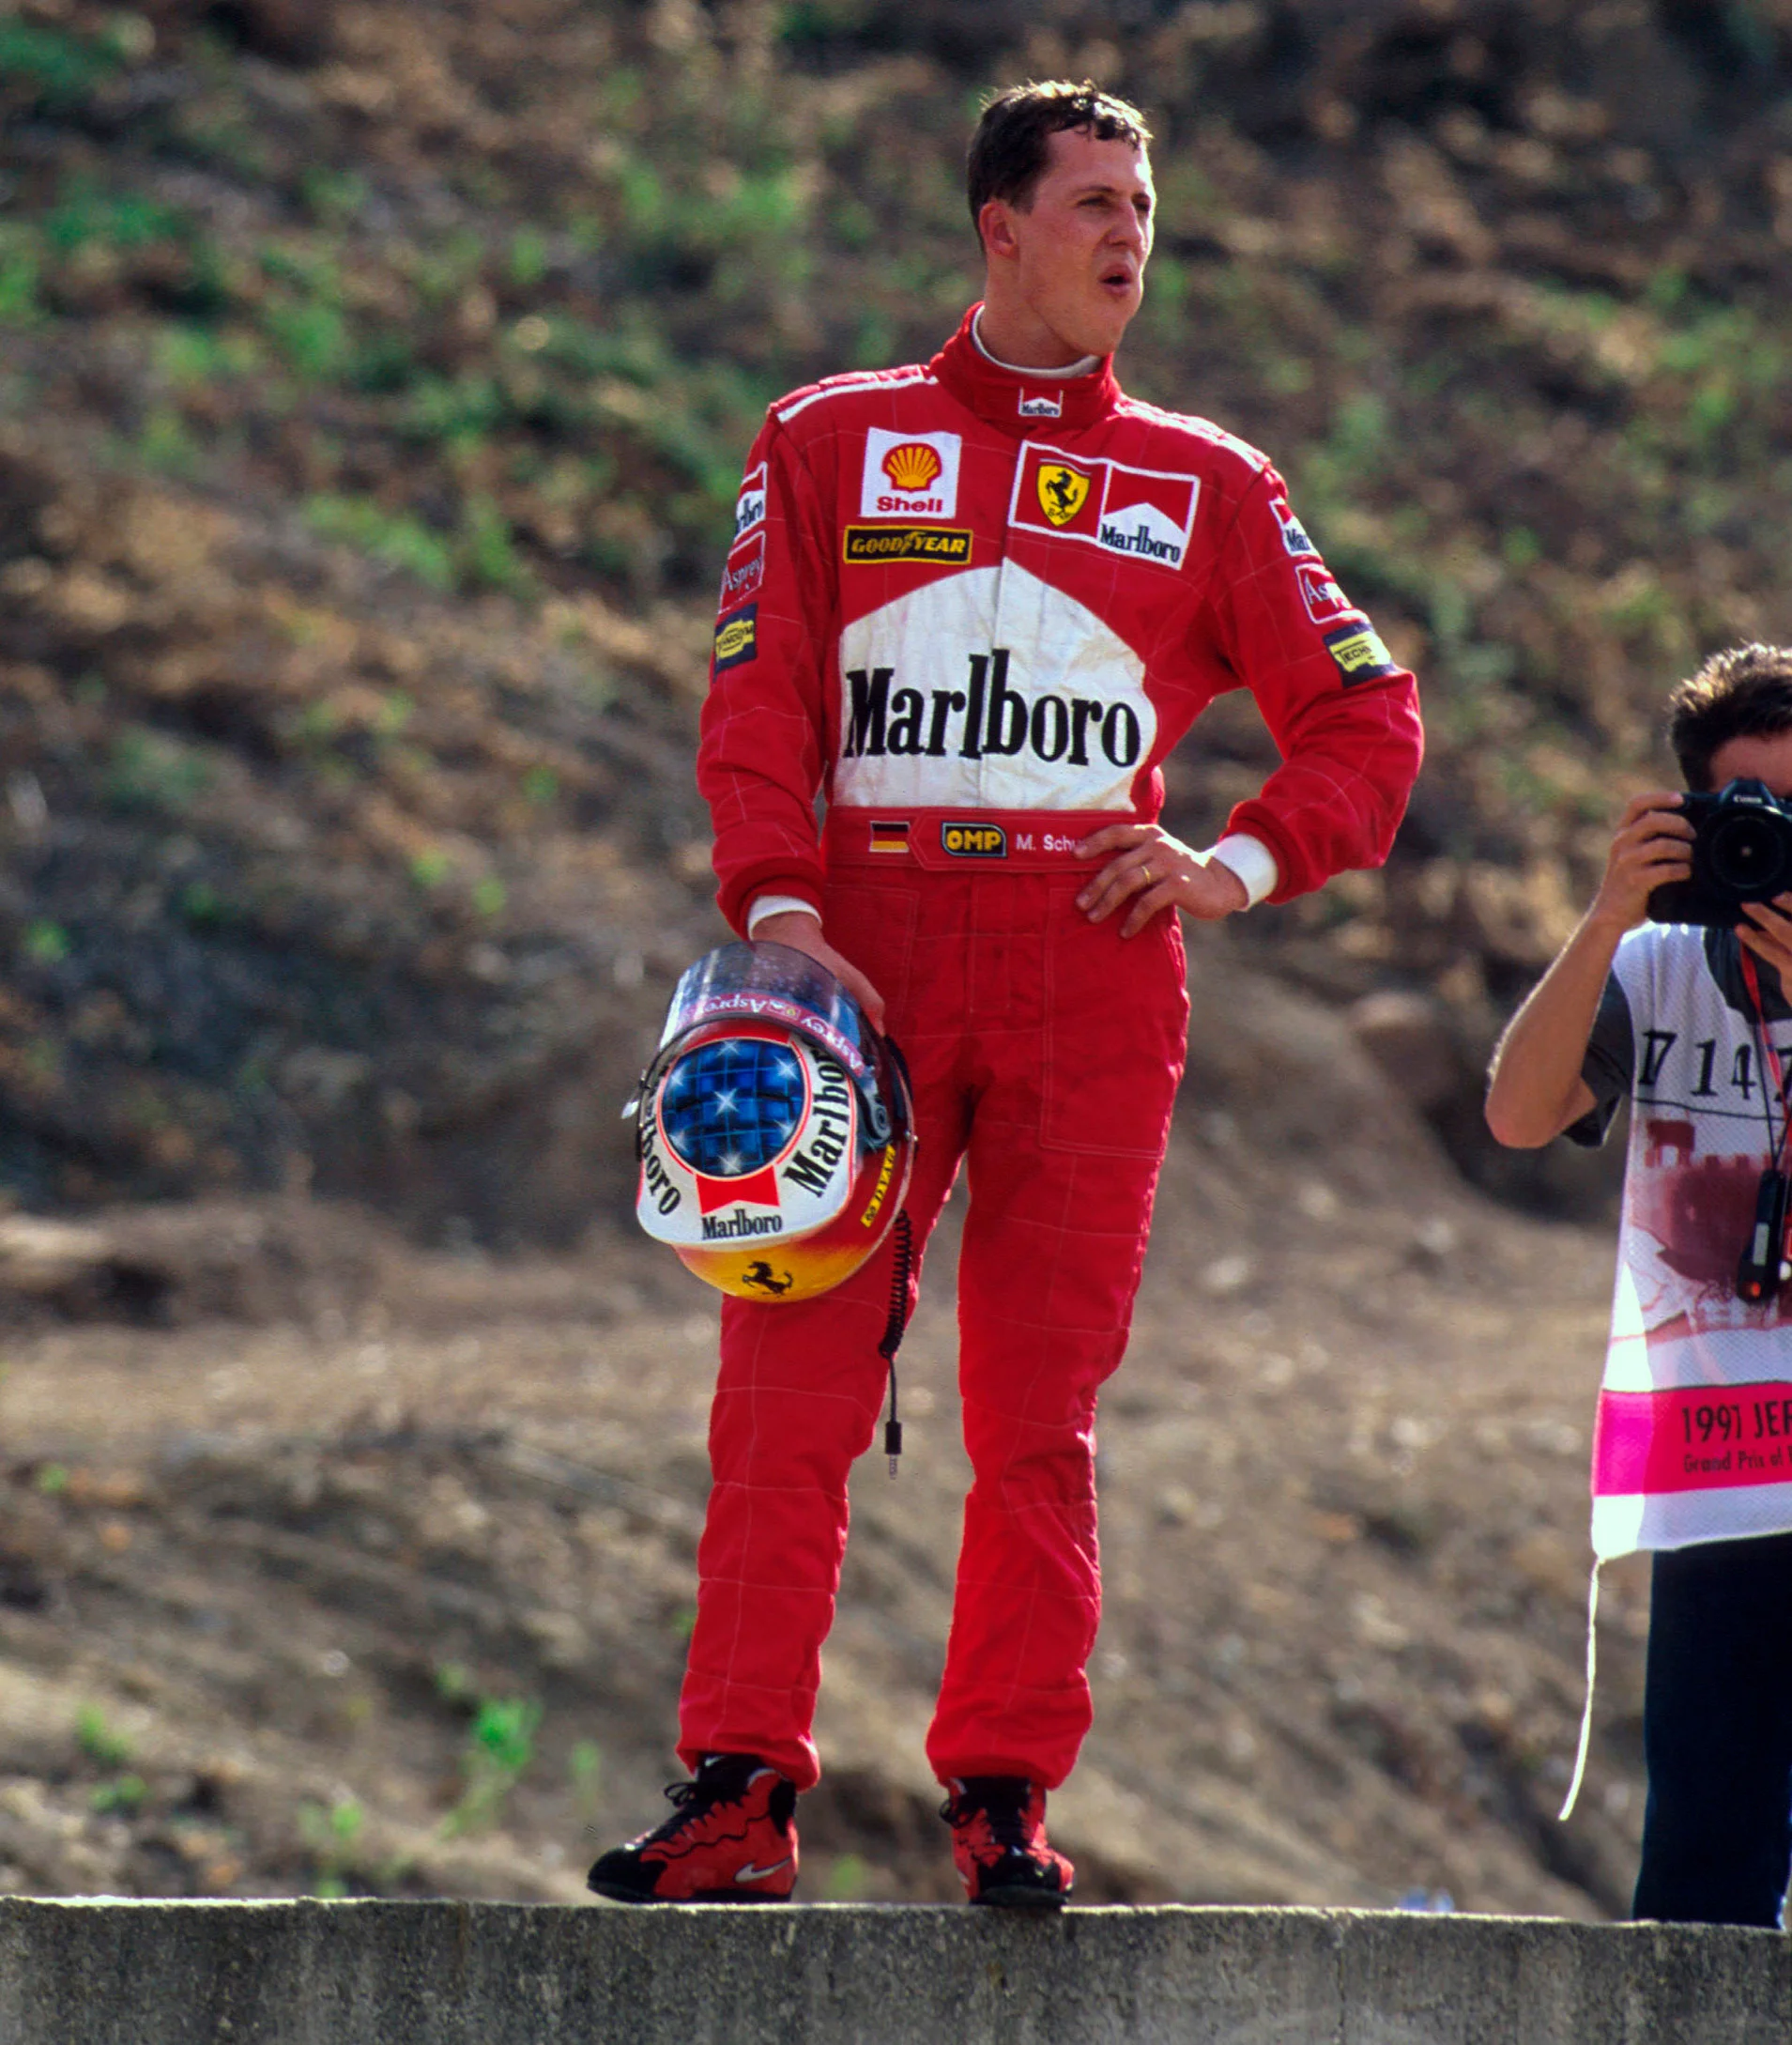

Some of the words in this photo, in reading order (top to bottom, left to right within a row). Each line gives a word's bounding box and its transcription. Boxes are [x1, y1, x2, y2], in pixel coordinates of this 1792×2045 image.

[876, 496, 943, 513] Shell
[850, 530, 967, 555] GOODYEAR
[1100, 523, 1181, 562] Marlboro
[843, 649, 1141, 767] Marlboro
[946, 830, 1002, 851] OMP
[1016, 834, 1036, 851] M.
[1043, 834, 1077, 852] Sch
[782, 1038, 850, 1198] Marlbo
[701, 1208, 783, 1240] Marlboro
[1684, 1449, 1731, 1473] Grand
